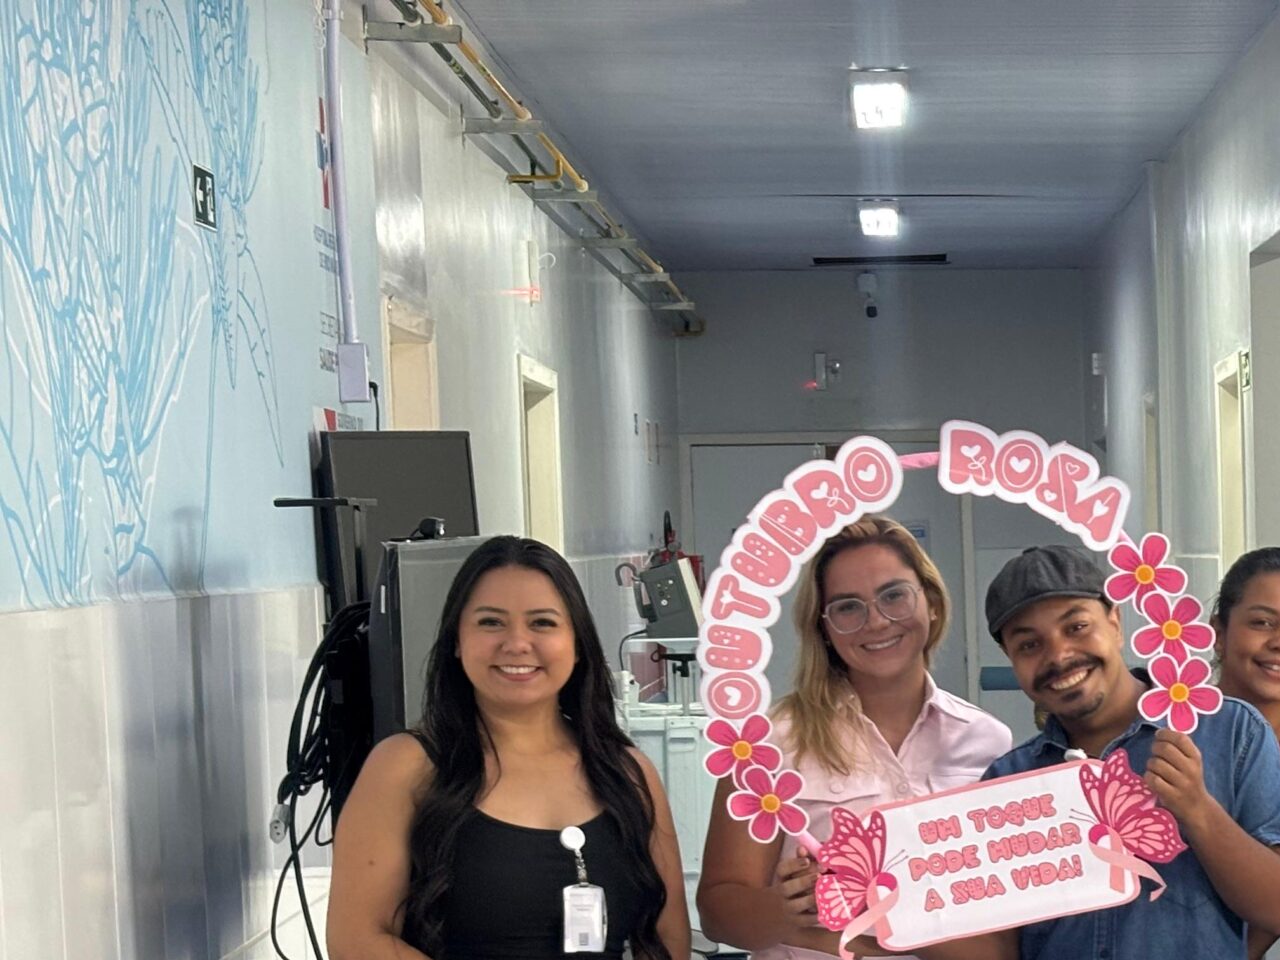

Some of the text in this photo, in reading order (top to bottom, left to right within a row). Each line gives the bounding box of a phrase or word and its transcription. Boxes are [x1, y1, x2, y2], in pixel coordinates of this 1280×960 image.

[705, 428, 1121, 719] OUTUBRO ROSA
[918, 794, 1058, 844] UM TOQUE
[909, 821, 1083, 881] PODE MUDAR
[924, 854, 1083, 912] A SUA VIDA!
